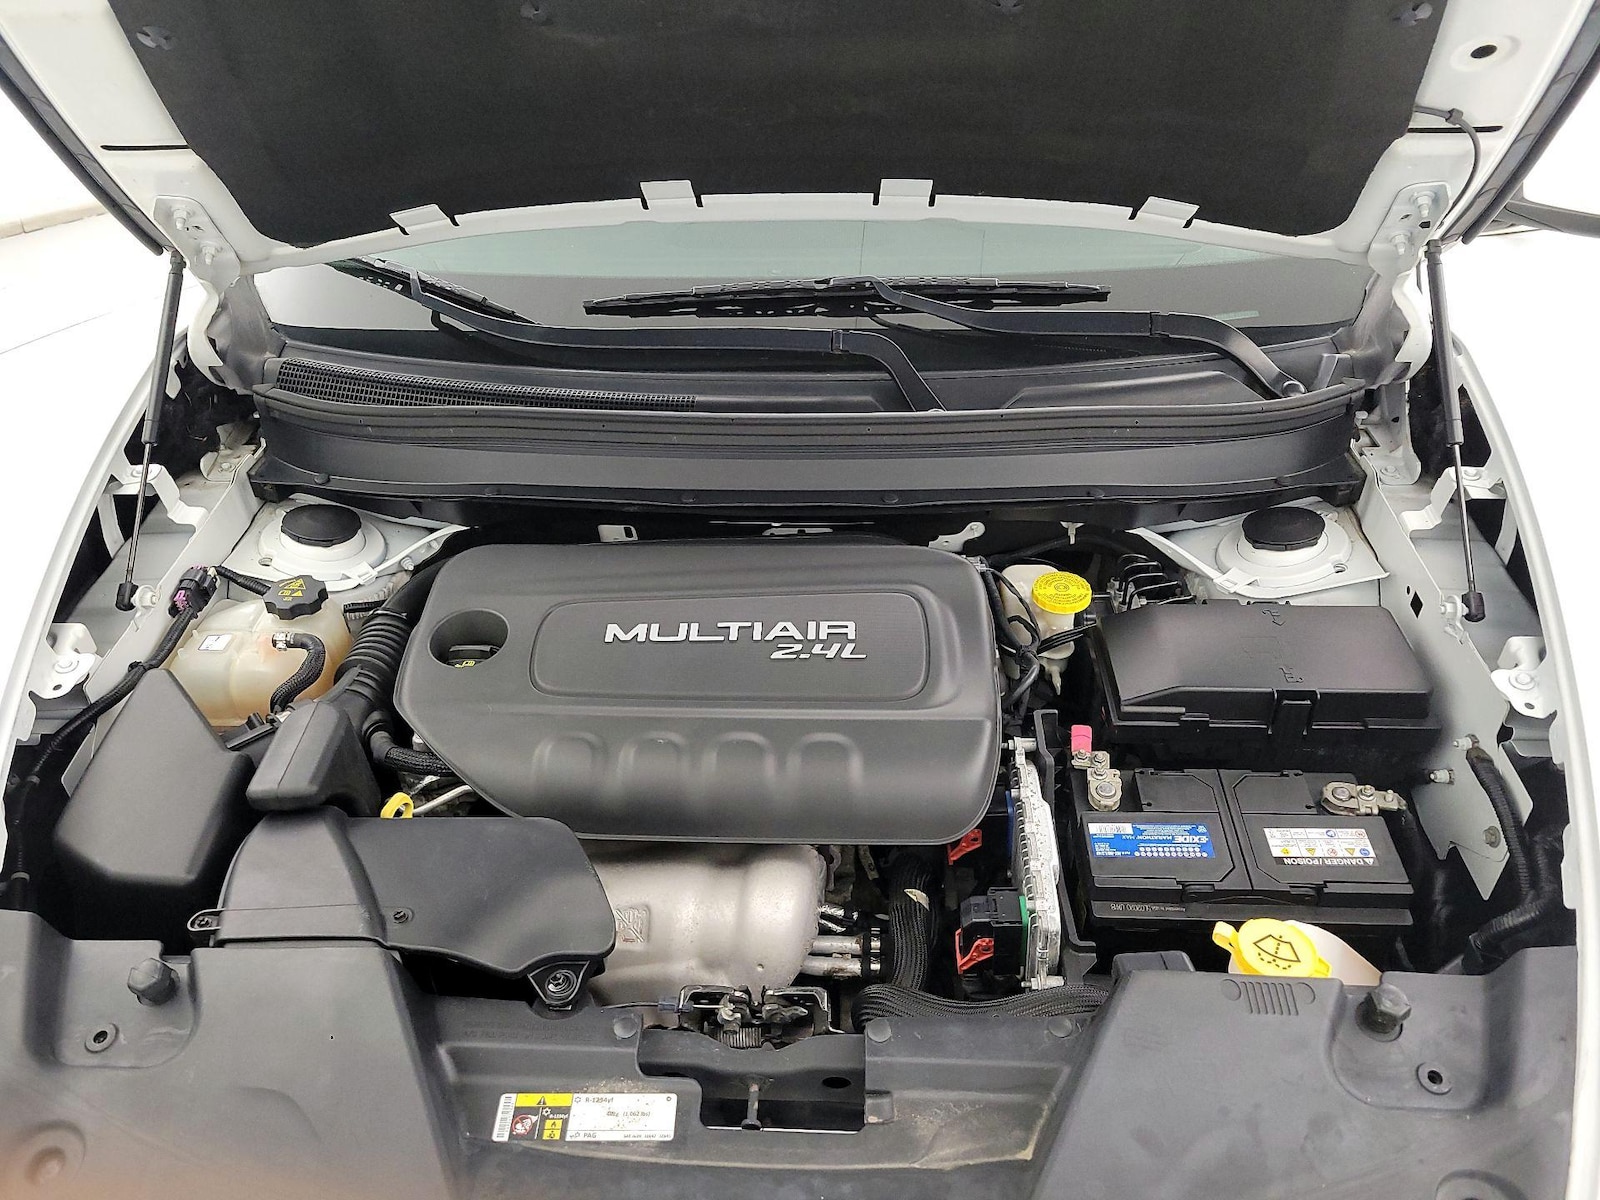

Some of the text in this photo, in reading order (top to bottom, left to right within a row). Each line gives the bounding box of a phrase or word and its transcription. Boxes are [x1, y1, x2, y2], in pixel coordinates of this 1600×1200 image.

[604, 621, 857, 643] MULTIAIR
[769, 643, 868, 660] 2.4L
[1172, 835, 1209, 844] EXIDE
[1283, 857, 1320, 865] POISON
[1324, 857, 1364, 865] DANGER
